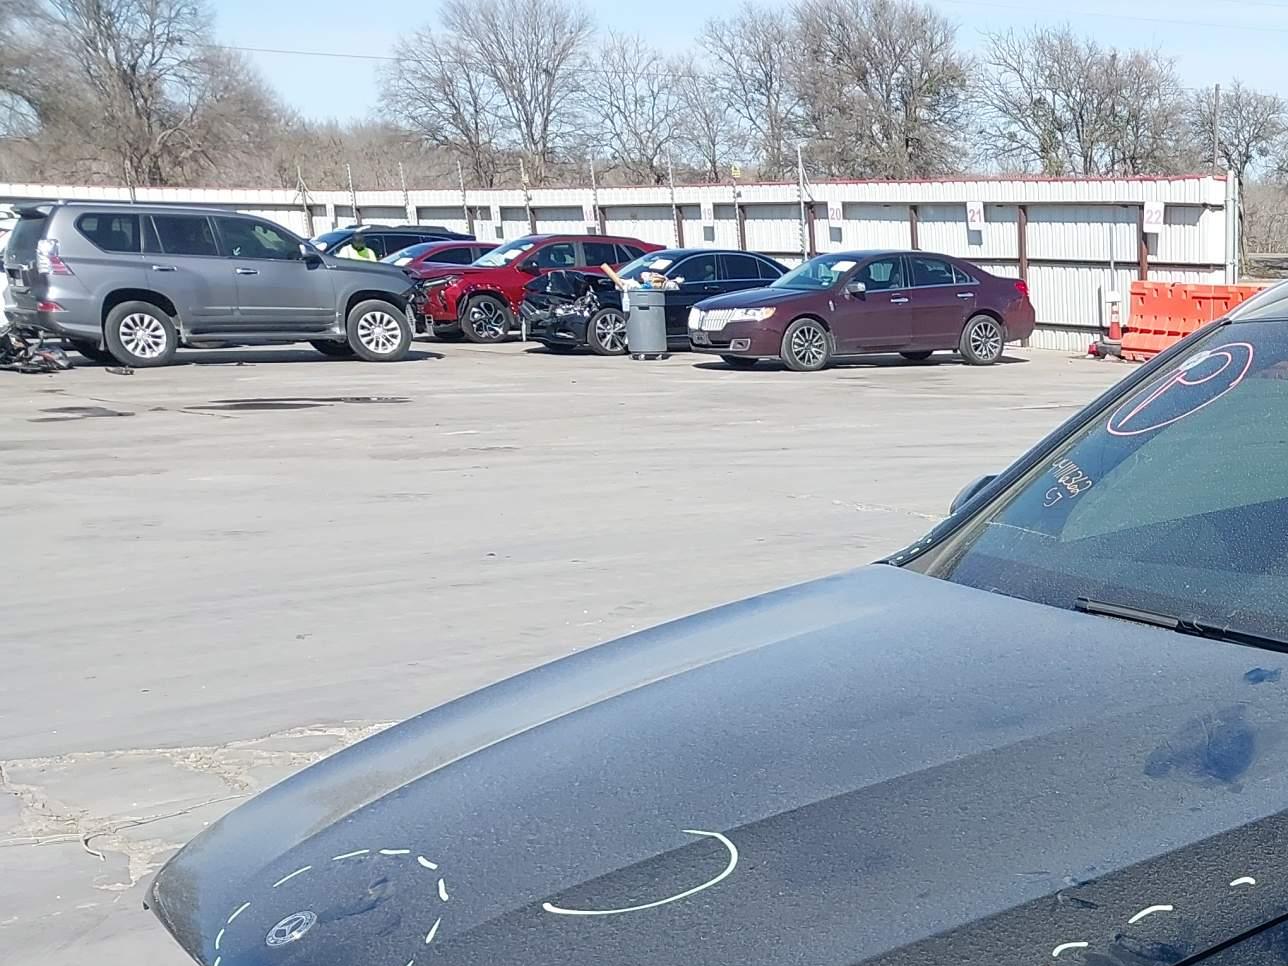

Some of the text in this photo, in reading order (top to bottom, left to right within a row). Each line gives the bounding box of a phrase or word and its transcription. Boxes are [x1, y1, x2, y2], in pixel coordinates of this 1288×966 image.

[829, 207, 842, 221] 20
[968, 208, 982, 223] 21
[1145, 209, 1163, 225] 22
